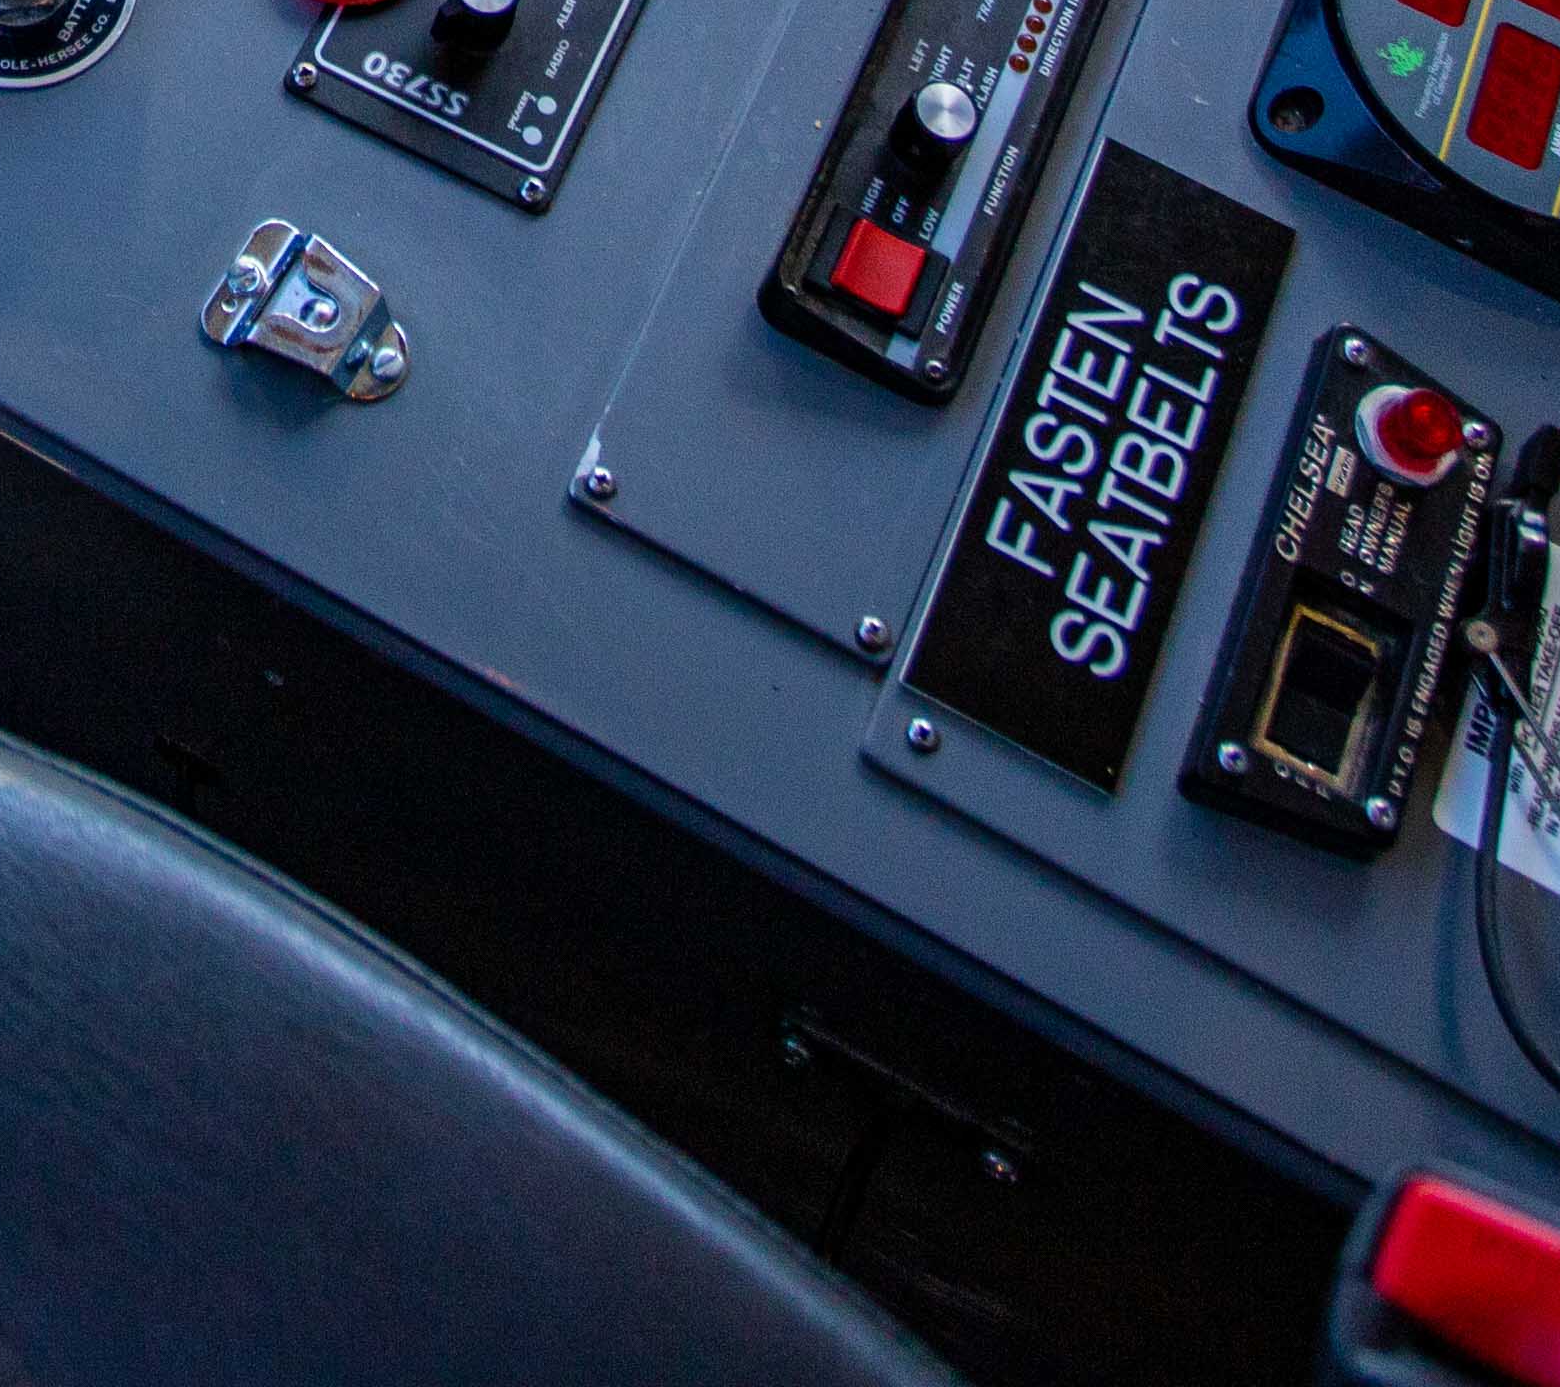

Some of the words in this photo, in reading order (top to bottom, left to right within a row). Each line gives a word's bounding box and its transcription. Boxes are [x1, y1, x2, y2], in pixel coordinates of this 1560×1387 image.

[545, 39, 571, 80] RADIO
[908, 38, 930, 73] LEFT
[1037, 7, 1075, 78] DIRECTION
[361, 50, 470, 119] SS730
[859, 176, 886, 215] HIGH
[982, 144, 1021, 217] FUNCTION
[891, 195, 911, 225] OFF
[918, 208, 940, 243] LOW
[934, 280, 966, 335] POWER
[985, 280, 1146, 580] FASTEN
[1049, 272, 1242, 683] SEATBELTS
[1275, 417, 1337, 563] CHELSEA
[1466, 480, 1487, 504] IS
[1472, 451, 1495, 481] ON
[1376, 501, 1413, 577] MANUAL
[1453, 502, 1480, 561] LIGHT
[1411, 621, 1451, 717] ENGAGED
[1405, 716, 1425, 740] IS
